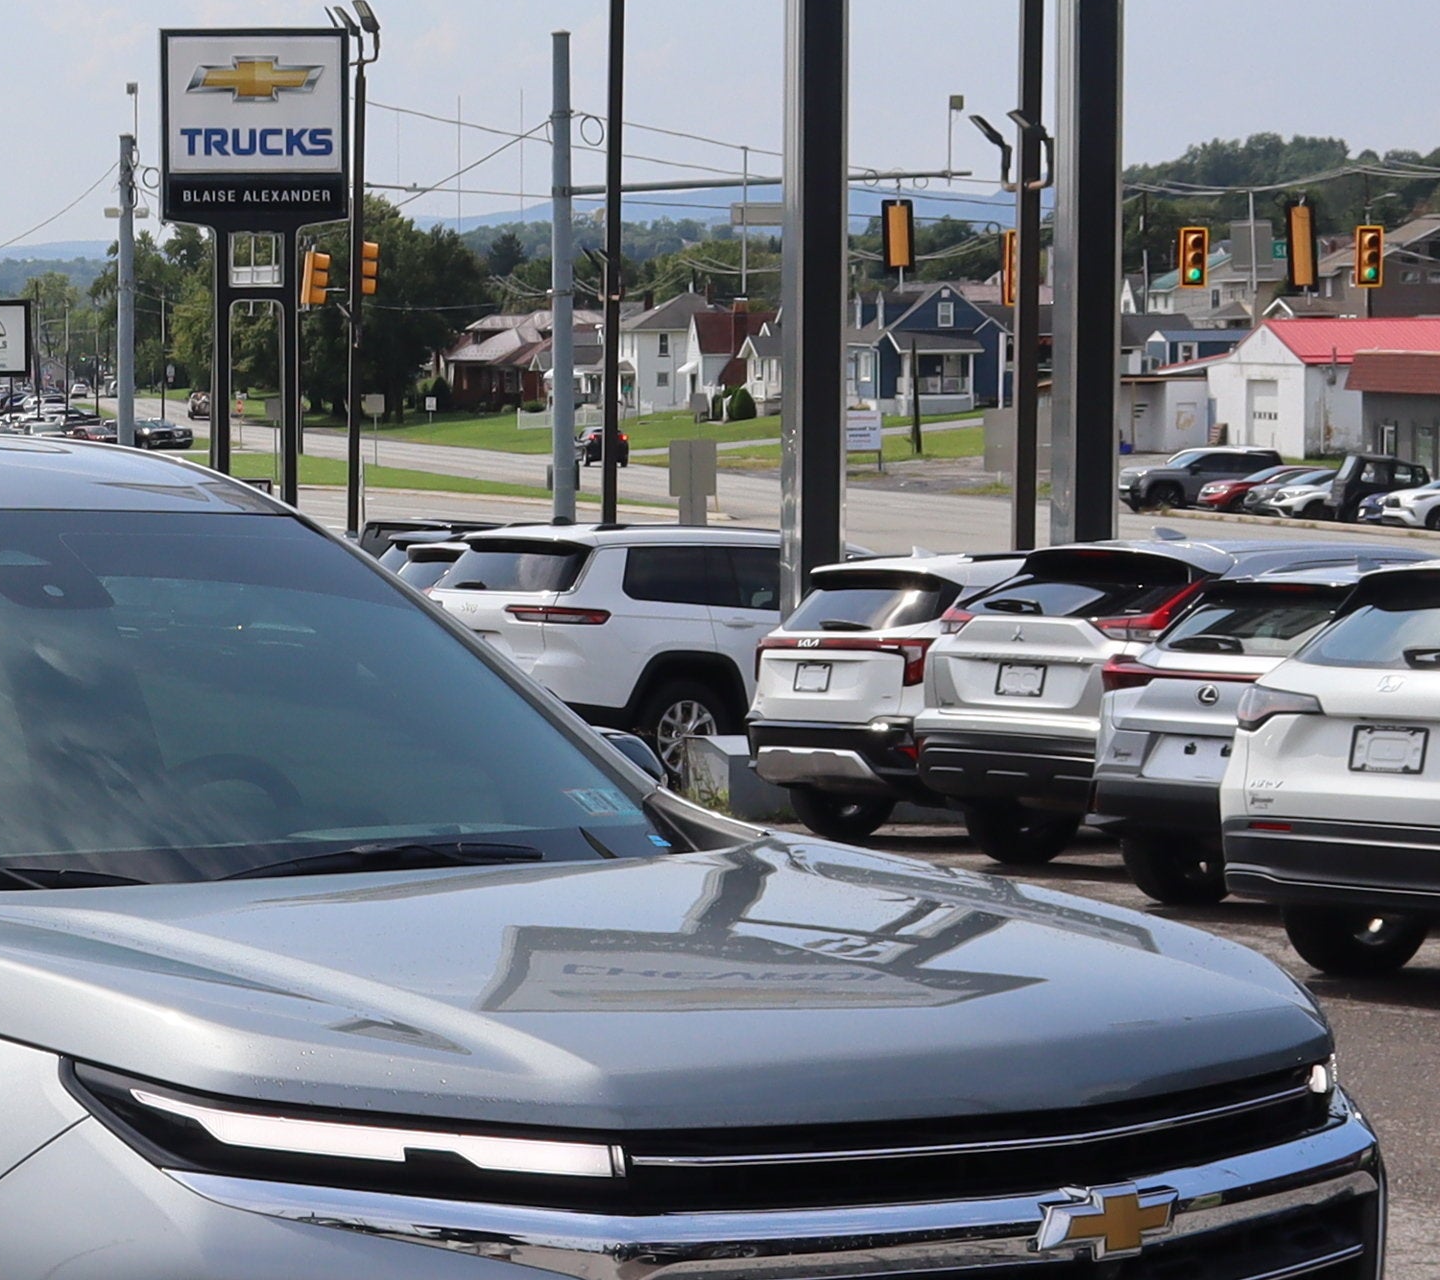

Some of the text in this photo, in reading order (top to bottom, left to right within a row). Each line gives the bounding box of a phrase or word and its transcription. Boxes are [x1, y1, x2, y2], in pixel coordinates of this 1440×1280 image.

[180, 128, 333, 156] TRUCKS
[183, 190, 331, 202] BLAISE ALEXANDER
